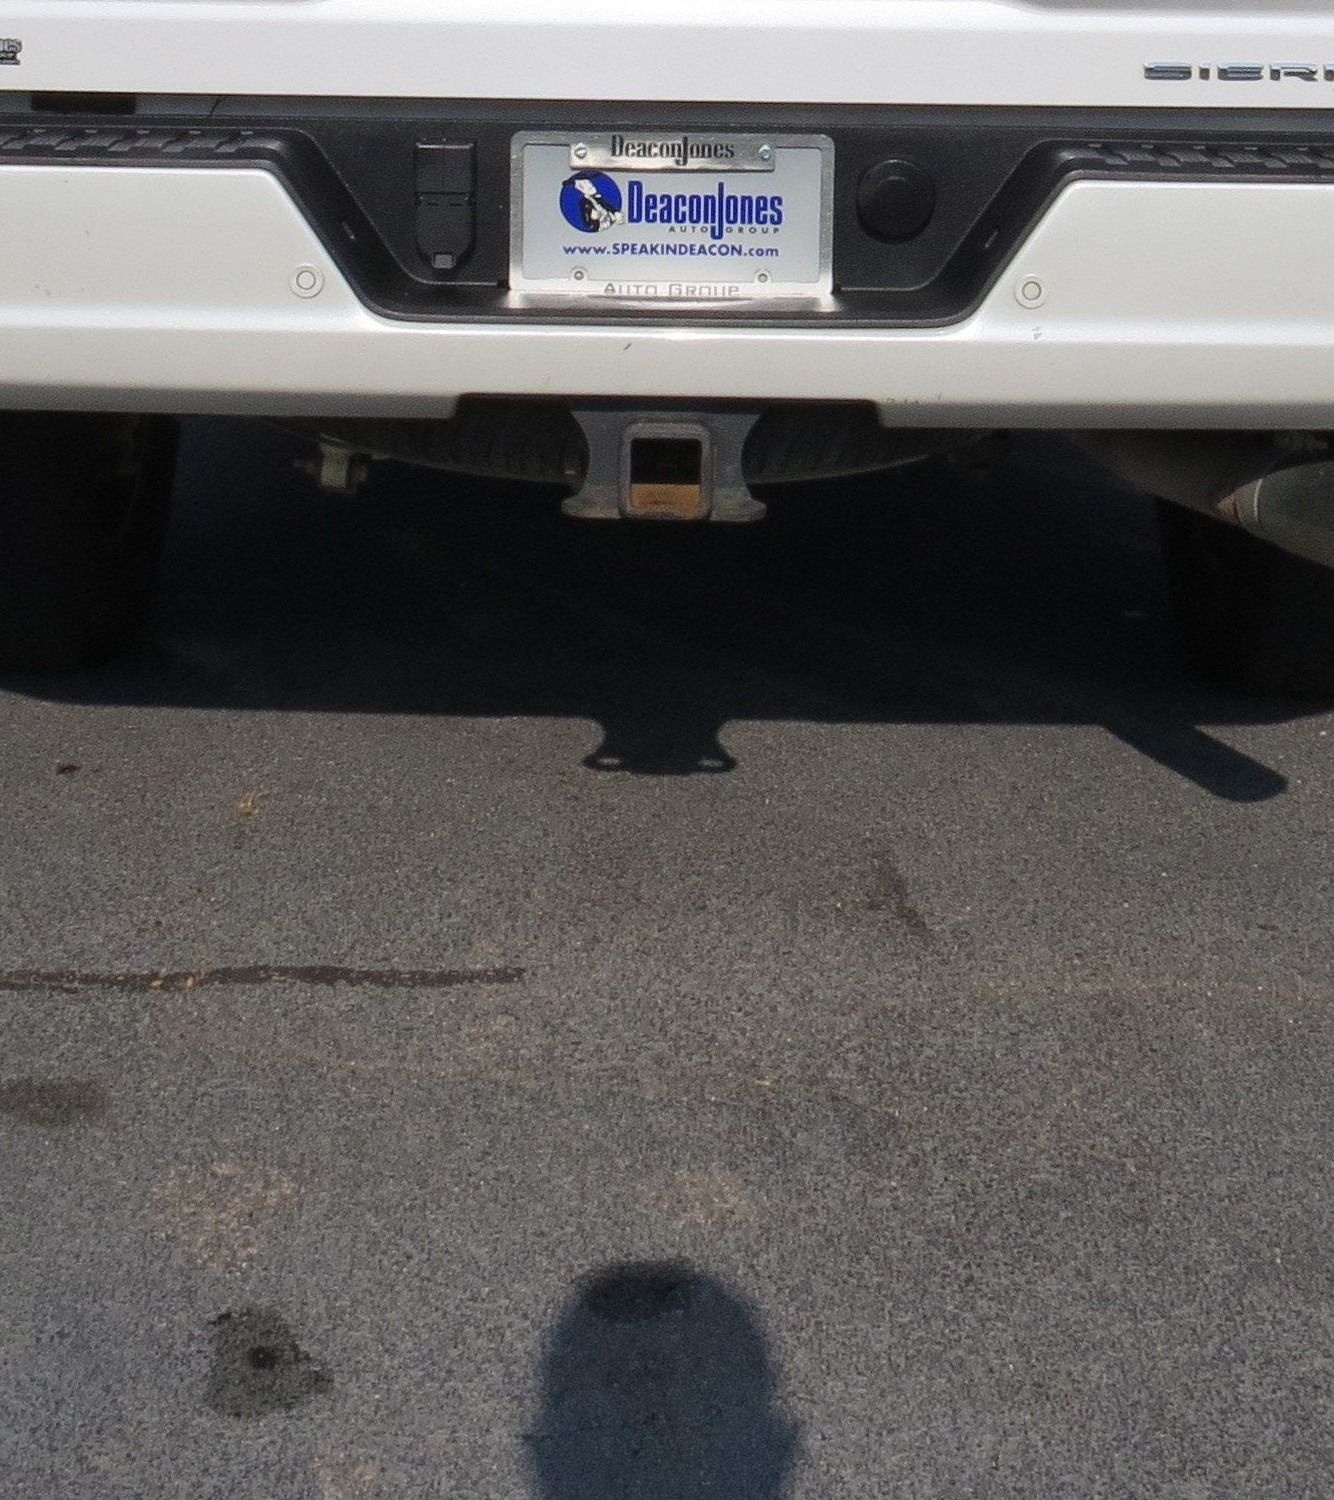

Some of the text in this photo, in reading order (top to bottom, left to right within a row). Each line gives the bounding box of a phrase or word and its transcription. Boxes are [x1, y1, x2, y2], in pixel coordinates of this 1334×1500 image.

[610, 135, 735, 166] DeaconJones
[627, 180, 784, 240] DeaconJones
[668, 225, 781, 235] AUTO GROUP
[563, 242, 780, 258] www.SPEAKINDEACON.com
